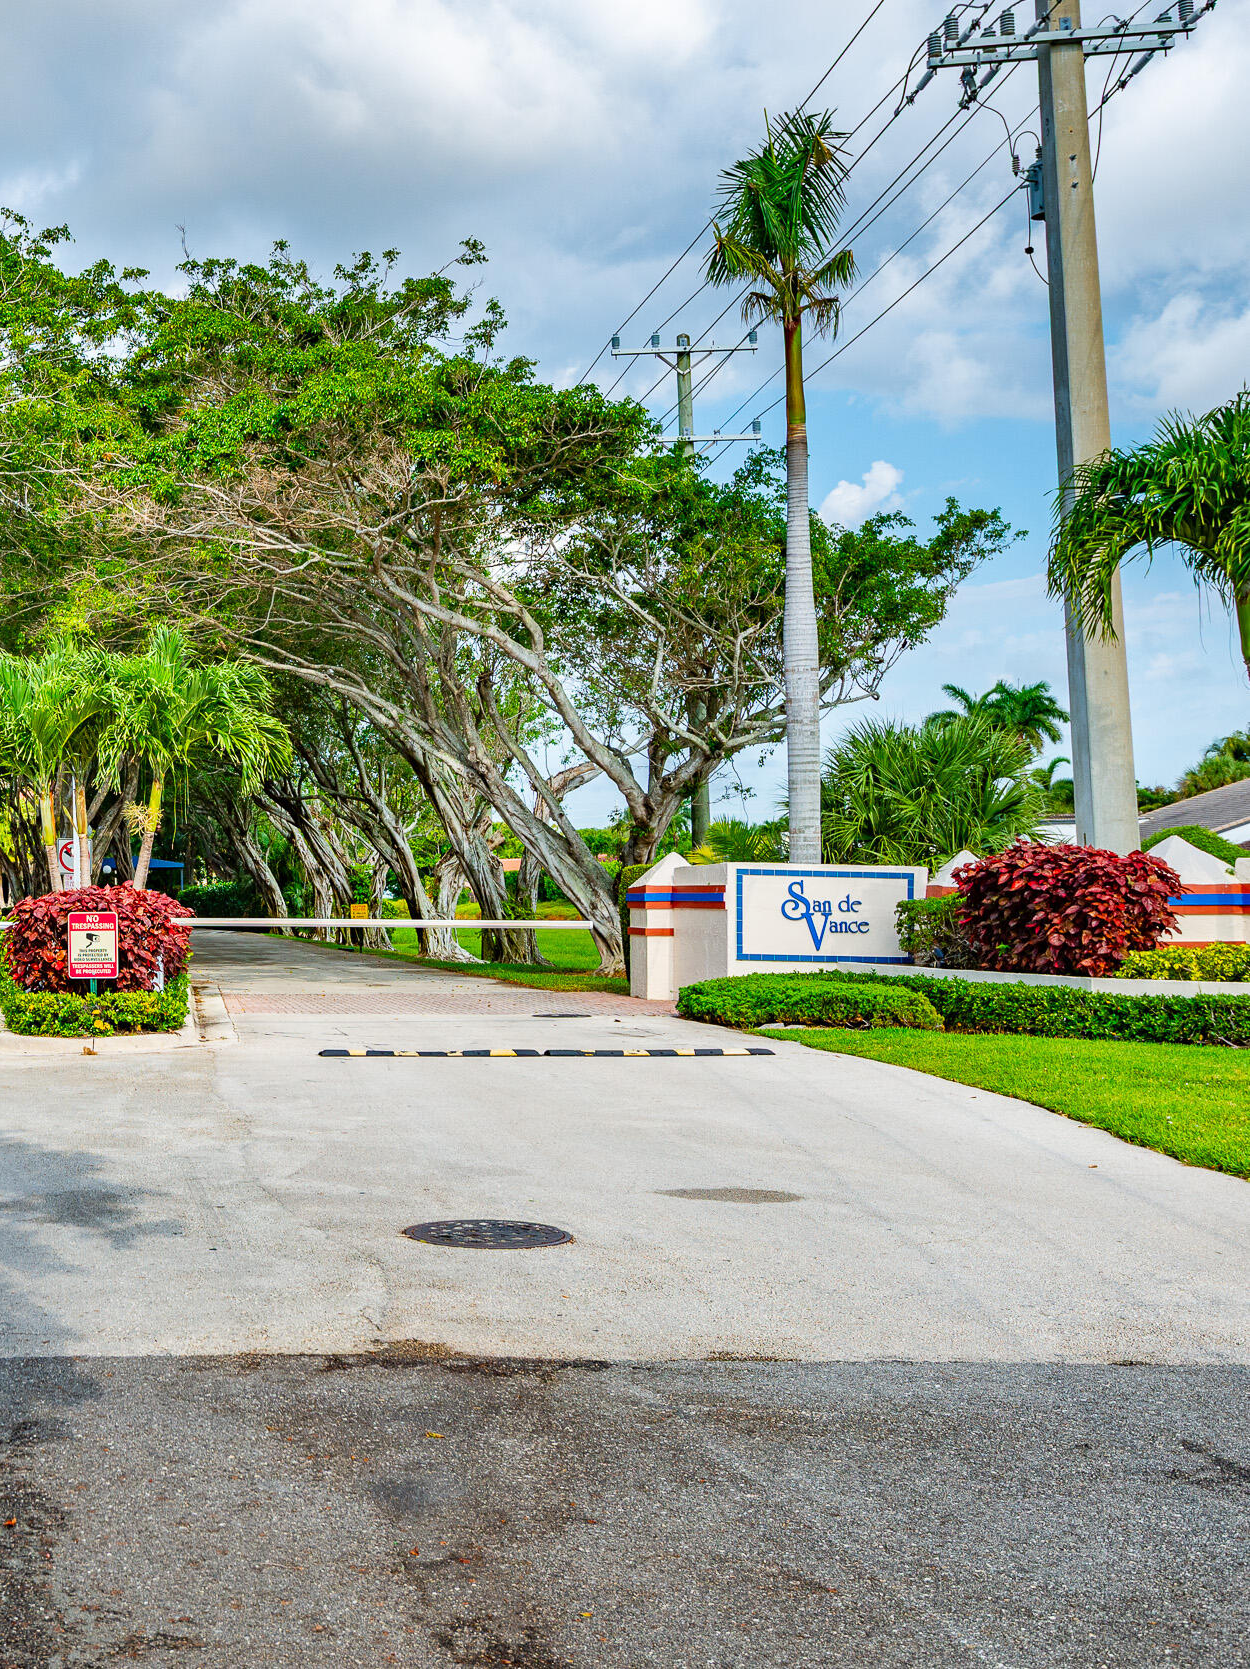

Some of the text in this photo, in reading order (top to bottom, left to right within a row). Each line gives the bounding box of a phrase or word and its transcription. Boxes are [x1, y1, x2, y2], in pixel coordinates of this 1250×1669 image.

[781, 880, 862, 921] San de
[801, 912, 870, 951] Vance
